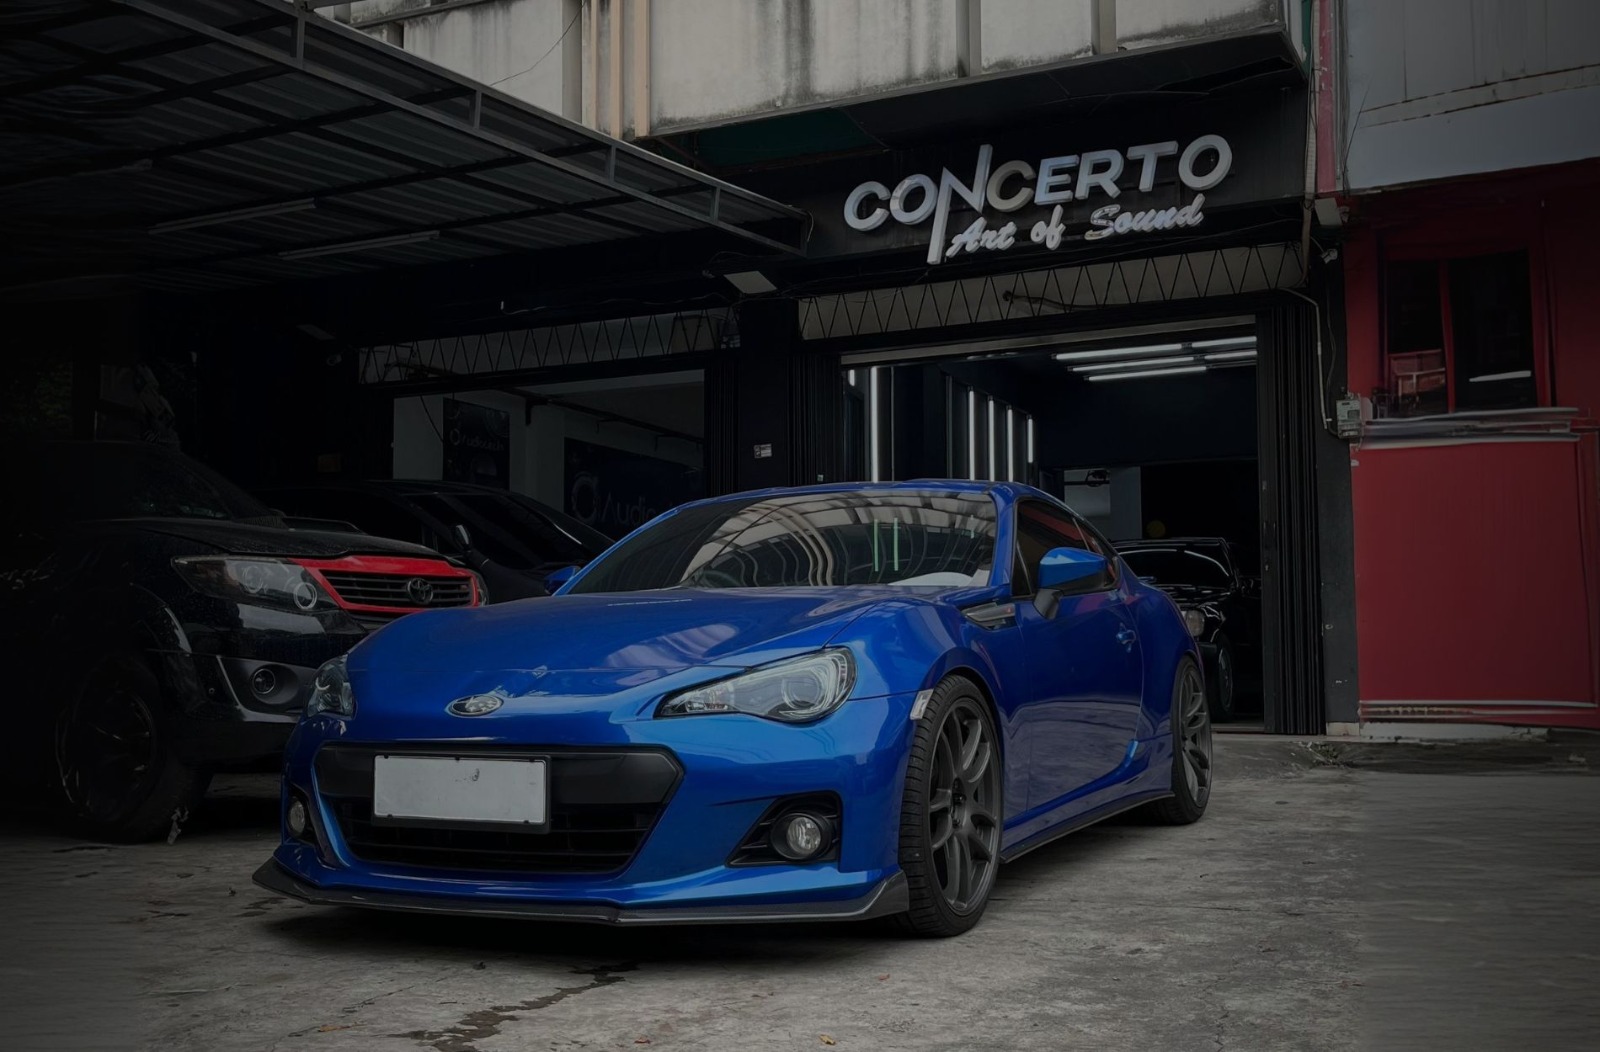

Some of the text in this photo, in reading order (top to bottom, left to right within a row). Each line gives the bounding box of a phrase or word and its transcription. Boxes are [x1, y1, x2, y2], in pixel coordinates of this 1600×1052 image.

[844, 134, 1233, 265] CONCERTO
[945, 193, 1206, 258] Art of Sound
